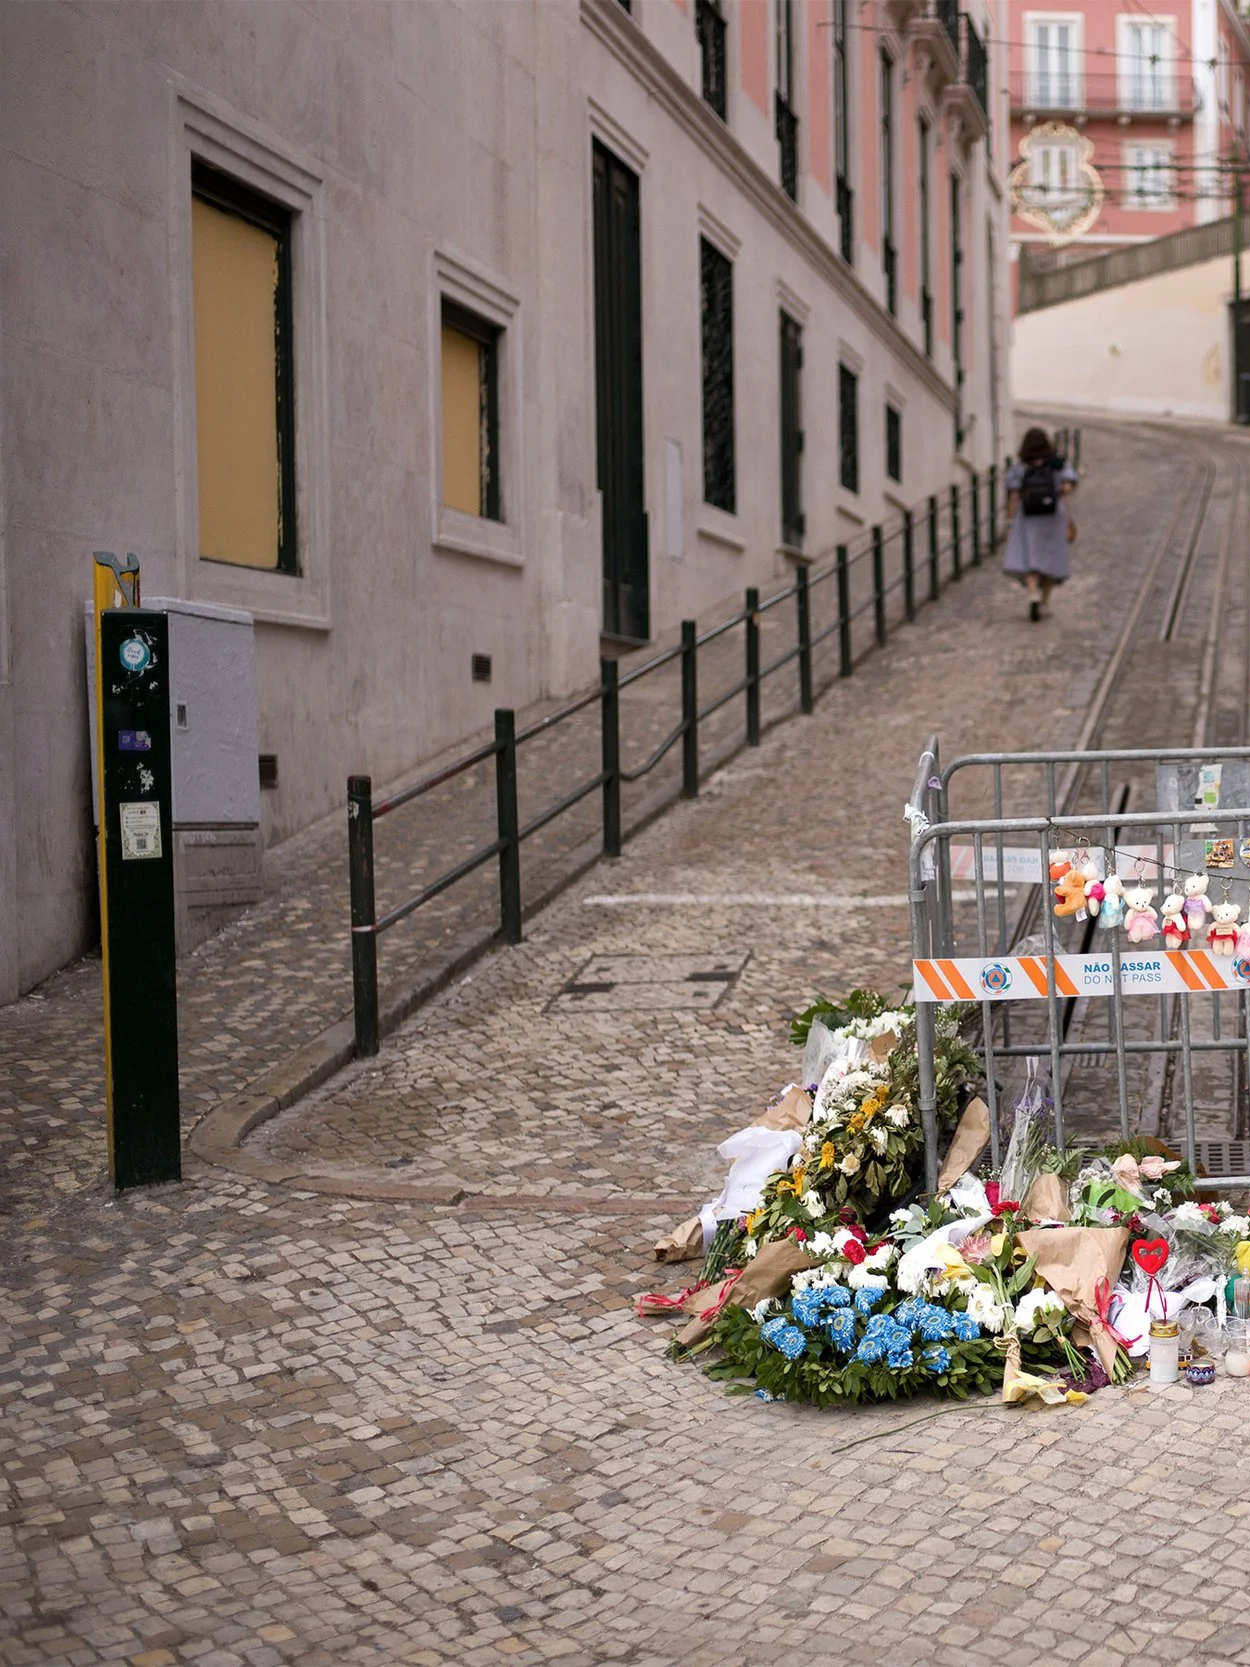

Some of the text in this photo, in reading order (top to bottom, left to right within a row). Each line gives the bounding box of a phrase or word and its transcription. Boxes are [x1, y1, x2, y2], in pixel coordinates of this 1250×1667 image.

[1084, 961, 1161, 973] NÃO ASSAR
[1084, 973, 1162, 985] DO NT PASS
